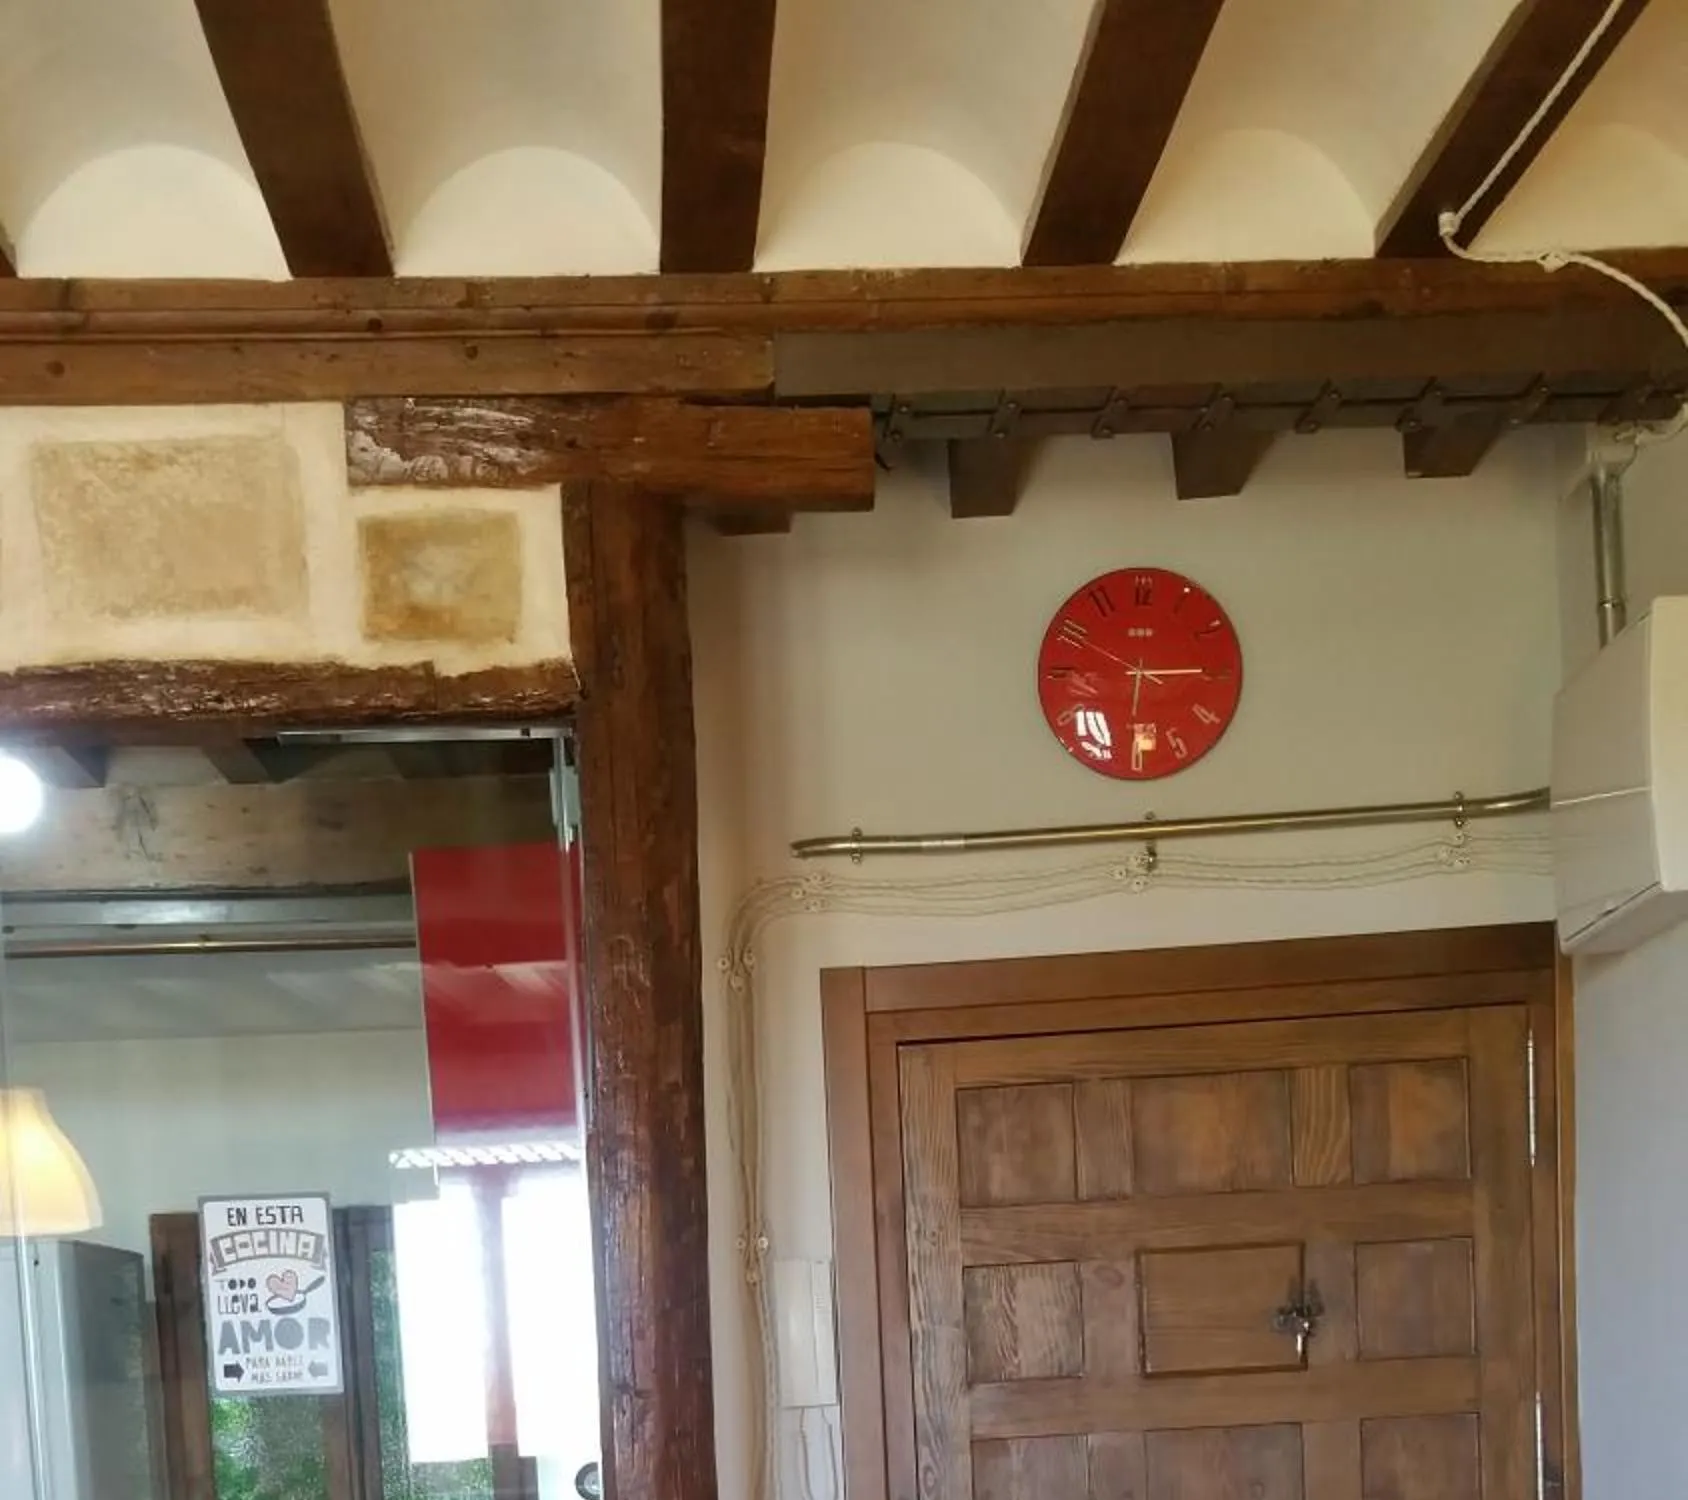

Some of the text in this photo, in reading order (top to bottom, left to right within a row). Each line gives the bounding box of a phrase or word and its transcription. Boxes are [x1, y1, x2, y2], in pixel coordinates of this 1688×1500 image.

[1135, 576, 1152, 606] 12
[1192, 703, 1220, 723] 4
[1166, 727, 1188, 759] 5
[227, 1205, 304, 1226] EN ESTA
[218, 1231, 317, 1261] COCINA
[215, 1277, 256, 1291] TODO
[218, 1318, 331, 1355] AMOR
